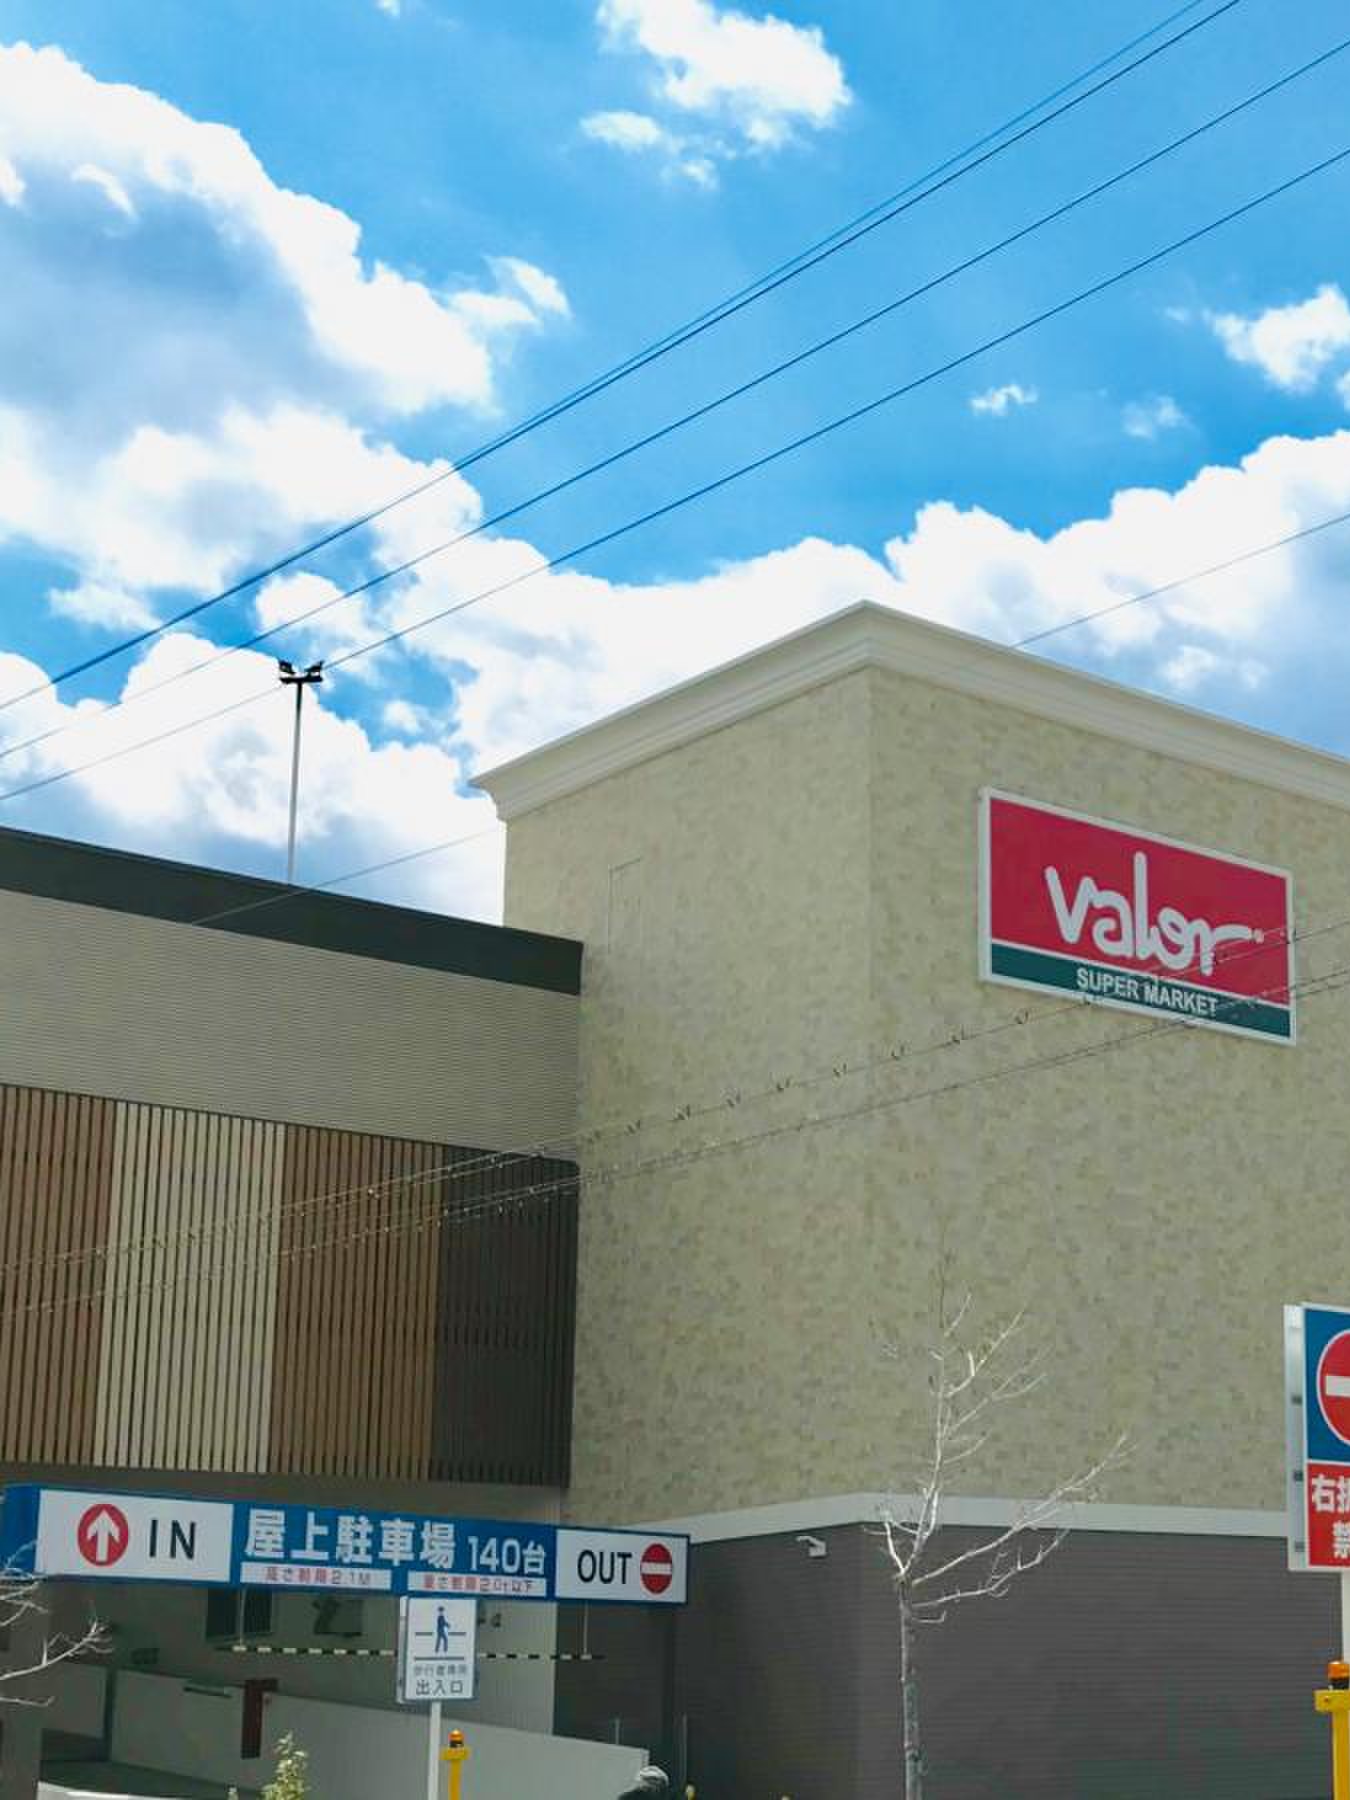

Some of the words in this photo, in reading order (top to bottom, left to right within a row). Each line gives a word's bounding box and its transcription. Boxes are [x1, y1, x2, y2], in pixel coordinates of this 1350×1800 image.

[1076, 968, 1139, 999] SUPER
[1143, 979, 1217, 1017] MARKET
[149, 1519, 196, 1560] IN
[244, 1508, 455, 1569] 屋上駐車場
[468, 1536, 546, 1575] 140台
[577, 1549, 632, 1585] OUT
[415, 1680, 463, 1696] 出入口
